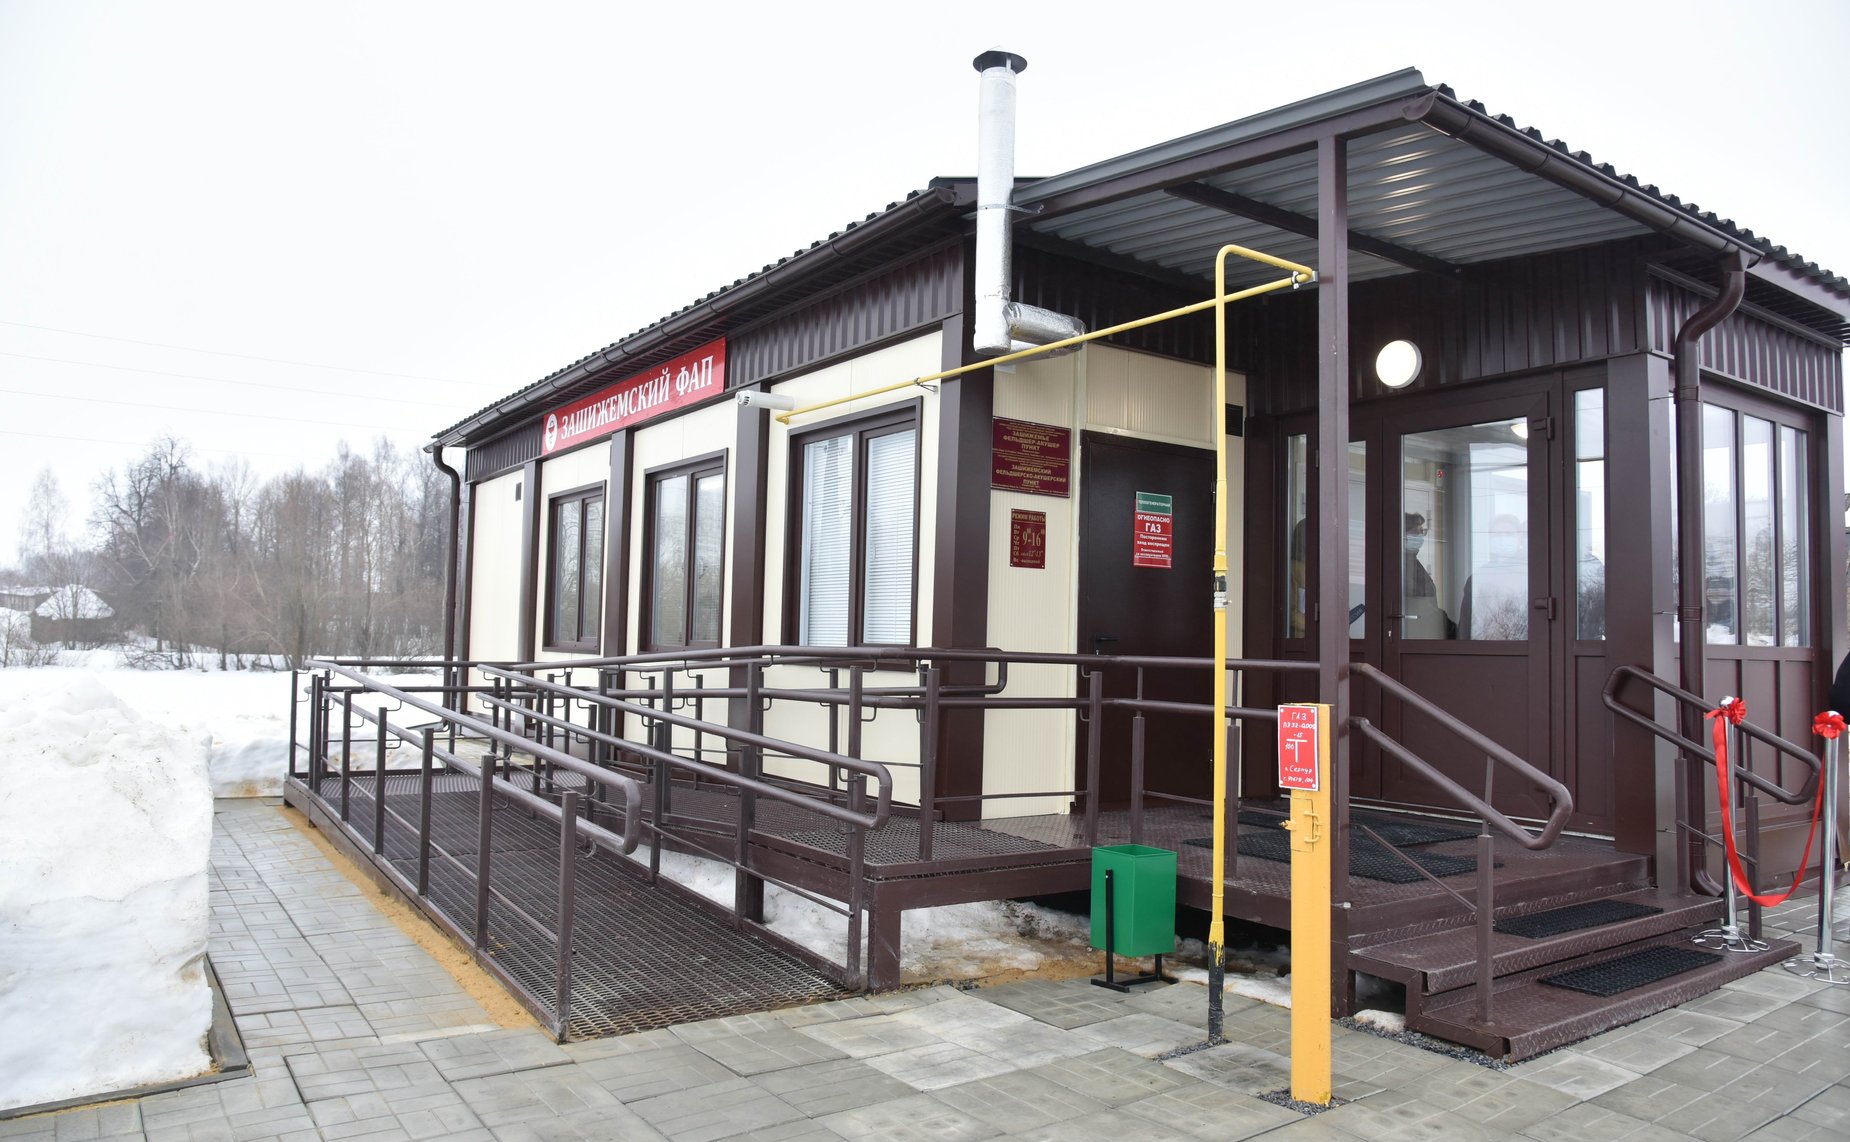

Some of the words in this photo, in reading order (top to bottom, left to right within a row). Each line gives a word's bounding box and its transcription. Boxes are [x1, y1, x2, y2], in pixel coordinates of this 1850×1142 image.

[561, 367, 671, 440] ЗАШИЖЕМСКИЙ
[675, 355, 713, 396] ФАП
[1003, 434, 1060, 448] ФЕЛЬДШЕР-АКУШЕР
[1137, 514, 1170, 523] ОГНЕОПАСНО
[1145, 523, 1161, 533] ГАЗ
[1291, 712, 1307, 721] ГАЗ
